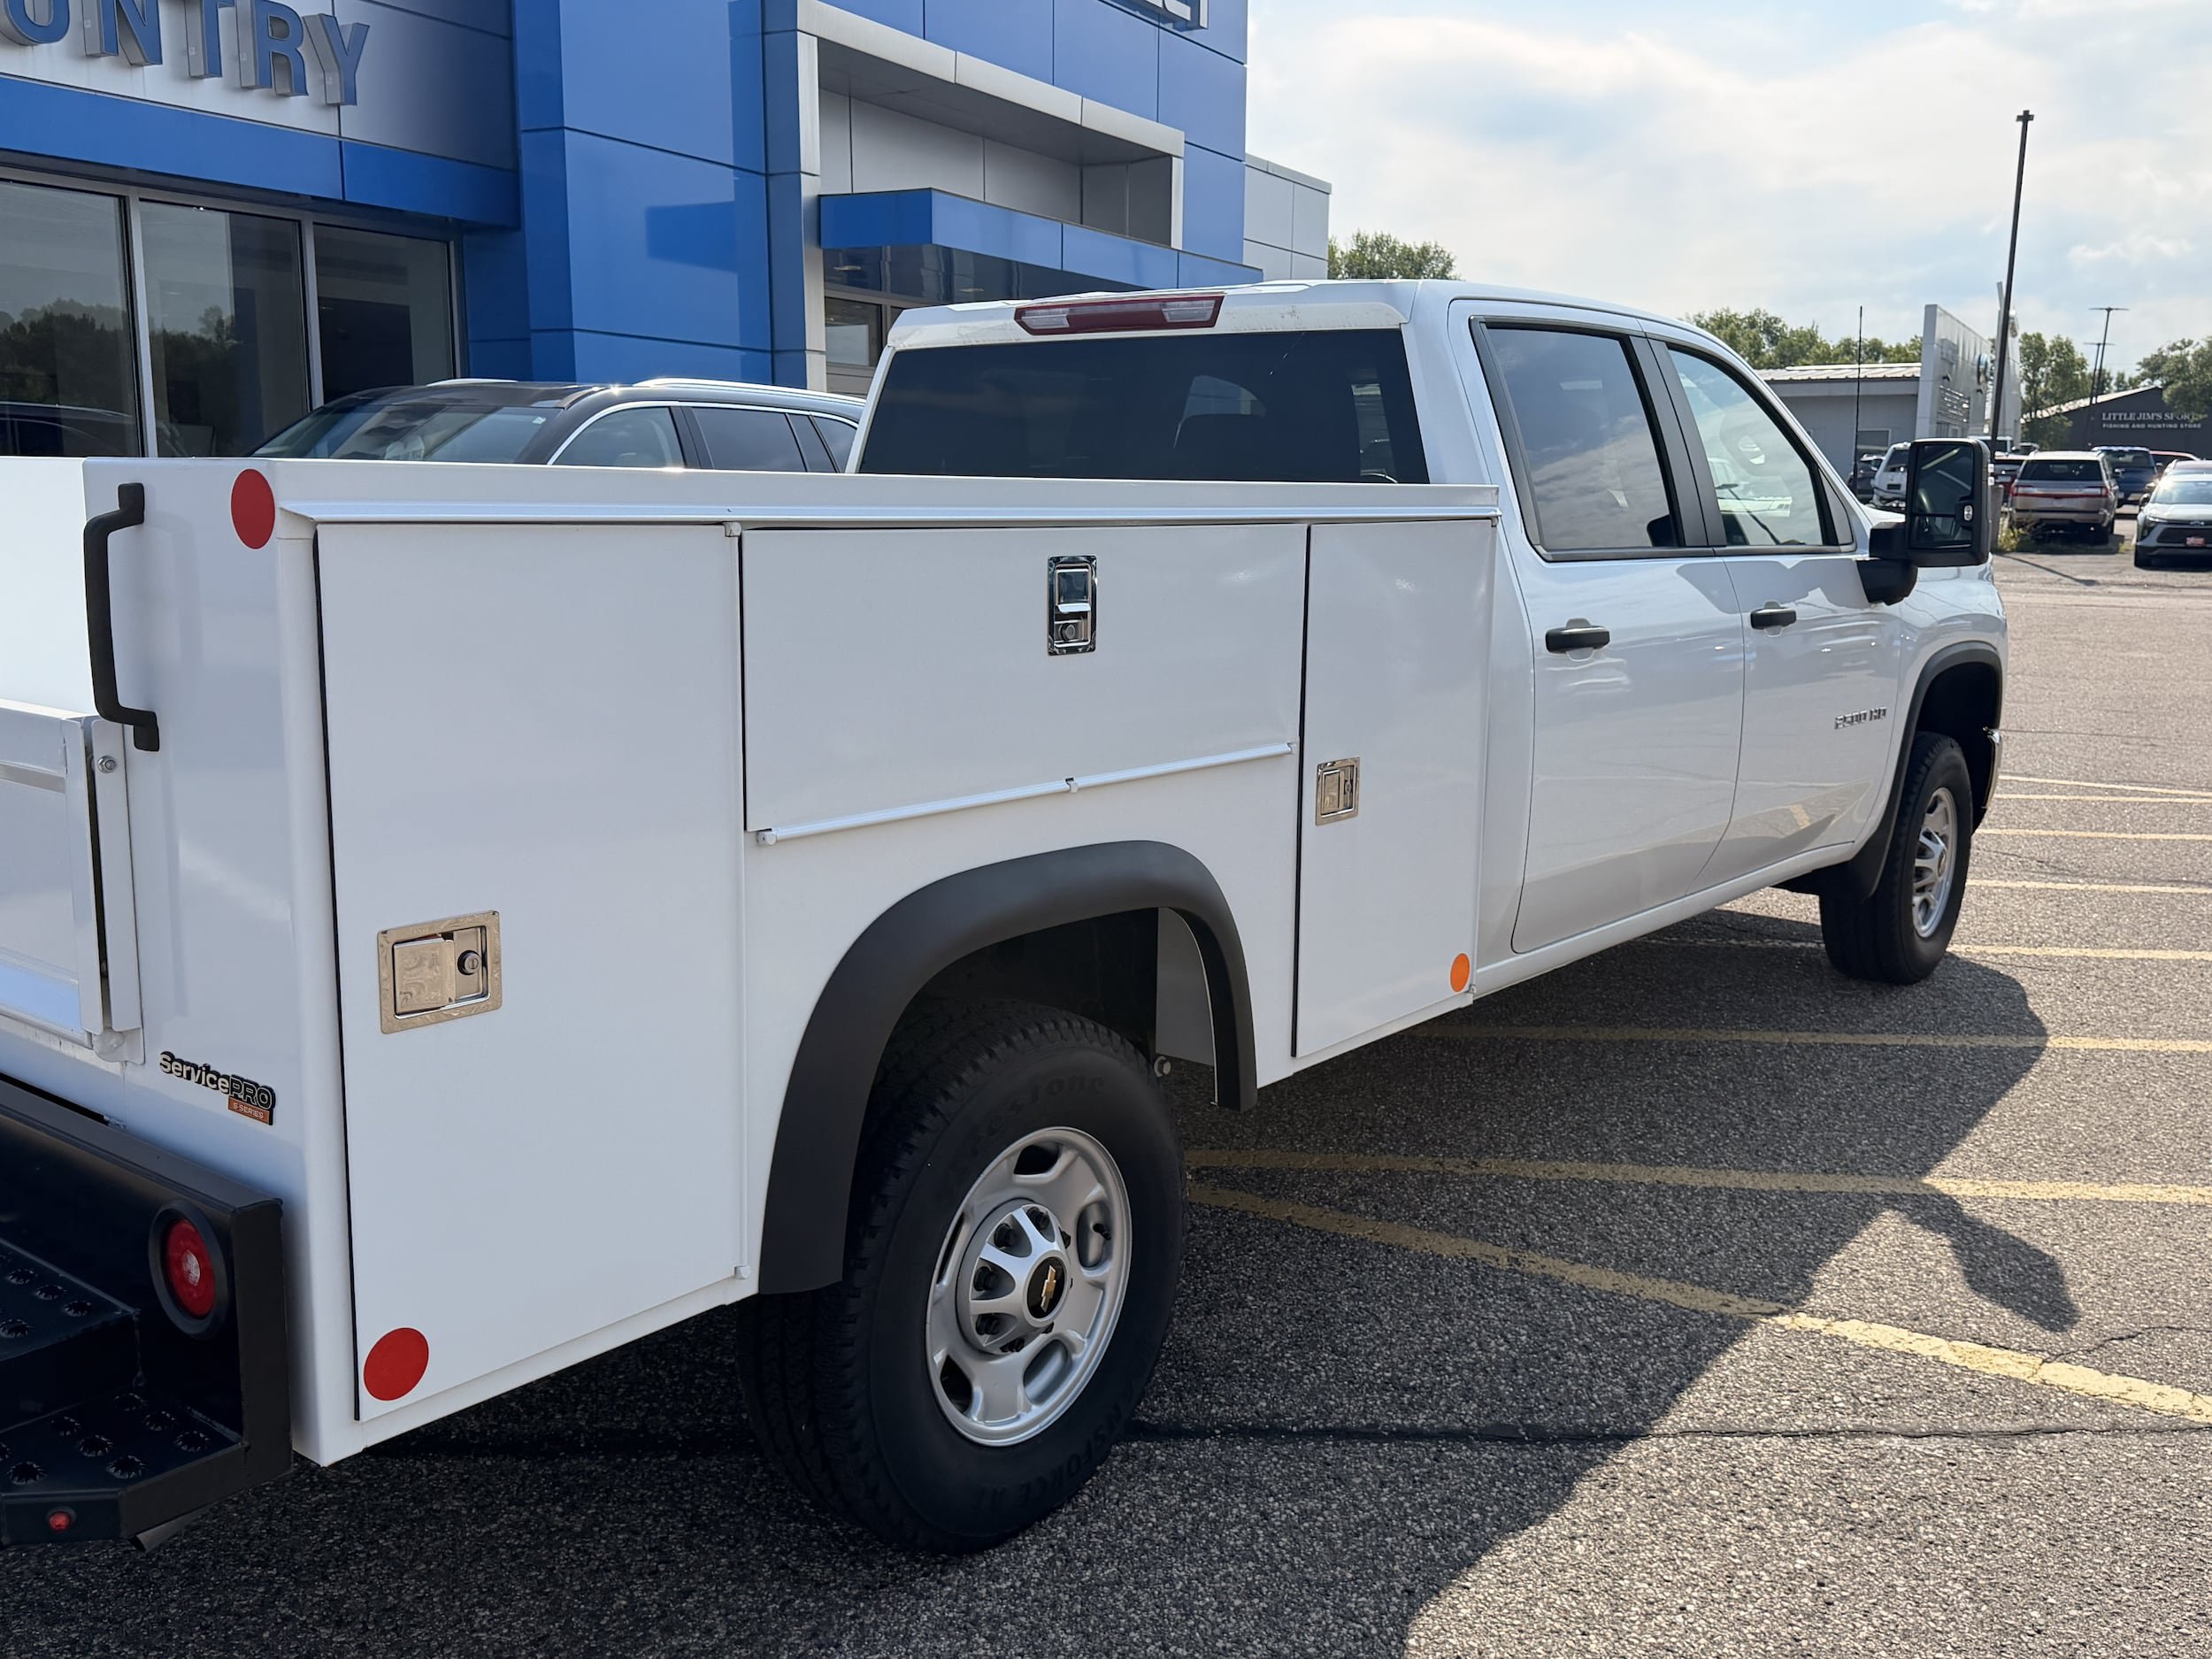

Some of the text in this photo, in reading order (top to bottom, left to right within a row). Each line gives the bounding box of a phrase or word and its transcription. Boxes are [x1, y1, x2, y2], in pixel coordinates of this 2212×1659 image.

[2101, 412, 2198, 421] LITTLE JIM'S SOR
